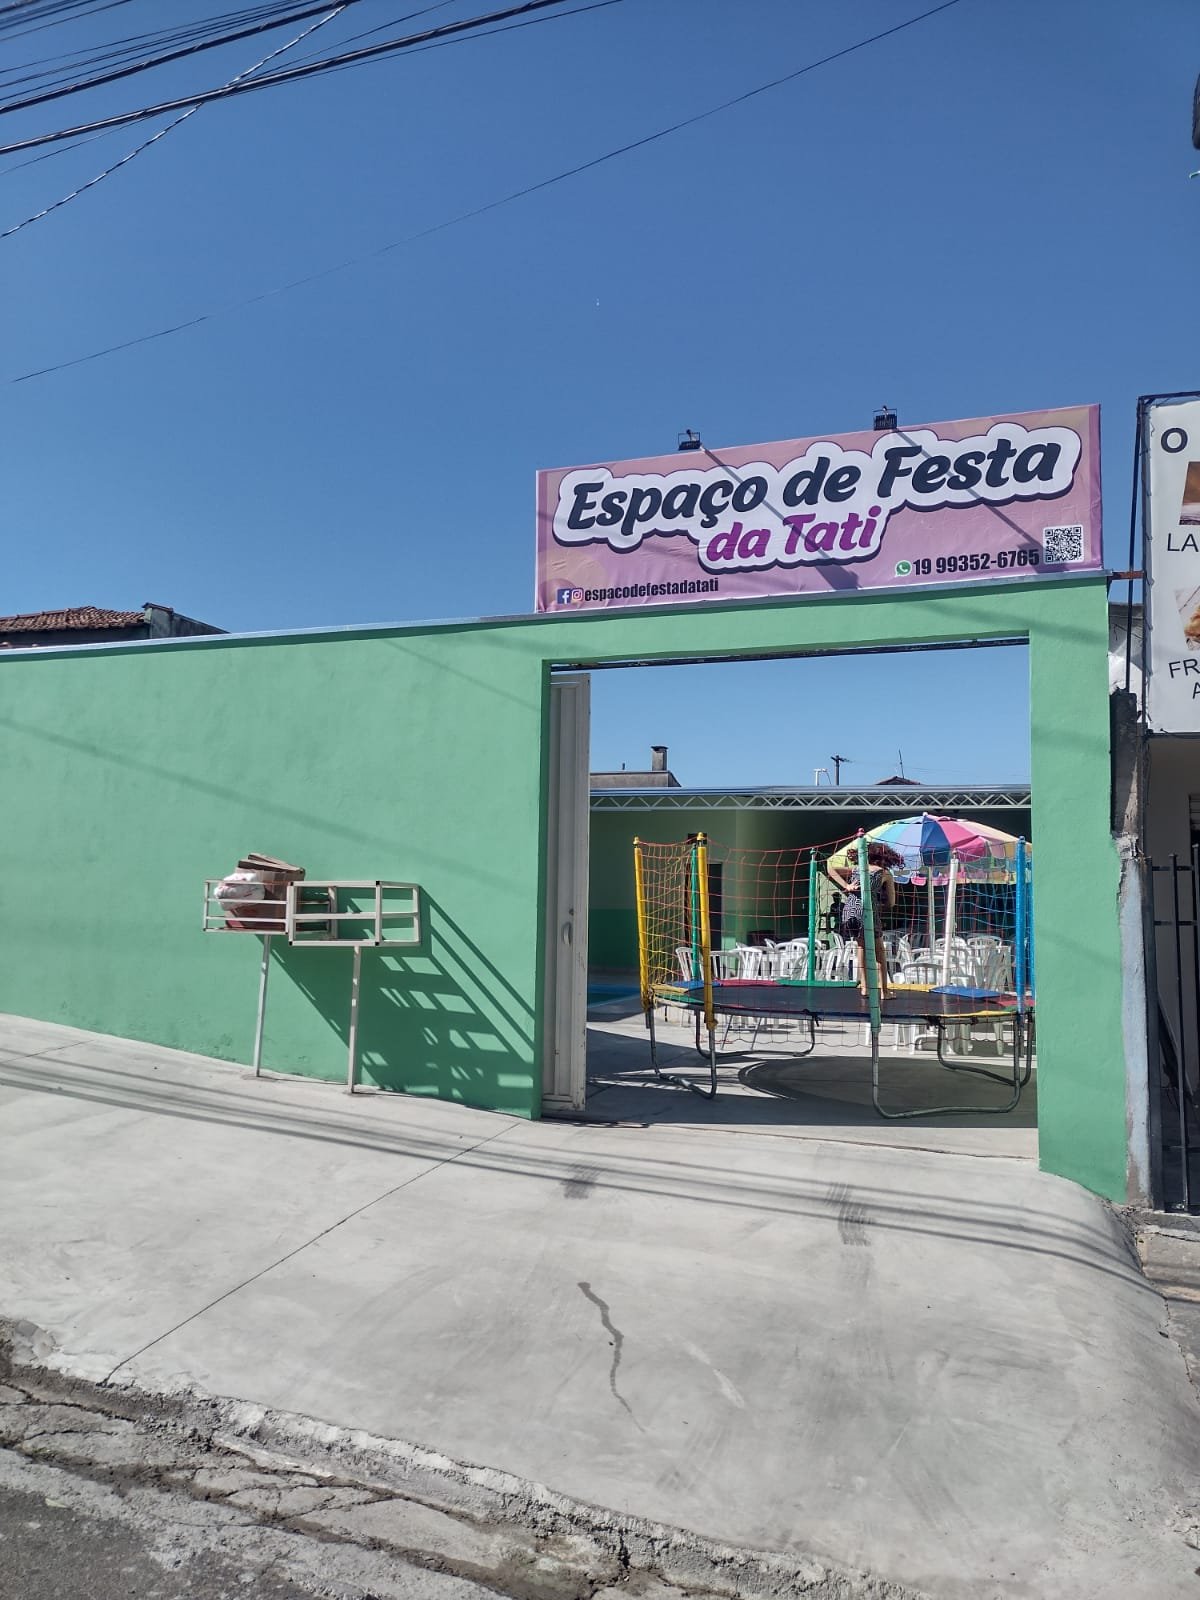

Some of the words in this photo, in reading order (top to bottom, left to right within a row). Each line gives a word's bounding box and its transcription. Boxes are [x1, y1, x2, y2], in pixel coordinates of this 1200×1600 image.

[567, 475, 768, 536] Espaço
[782, 456, 861, 507] de
[876, 438, 1062, 498] Festa
[706, 521, 771, 561] da
[783, 505, 882, 555] Tati
[913, 558, 932, 575] 19
[936, 549, 1040, 574] 99352-6765
[584, 578, 719, 602] espacodefestadatati
